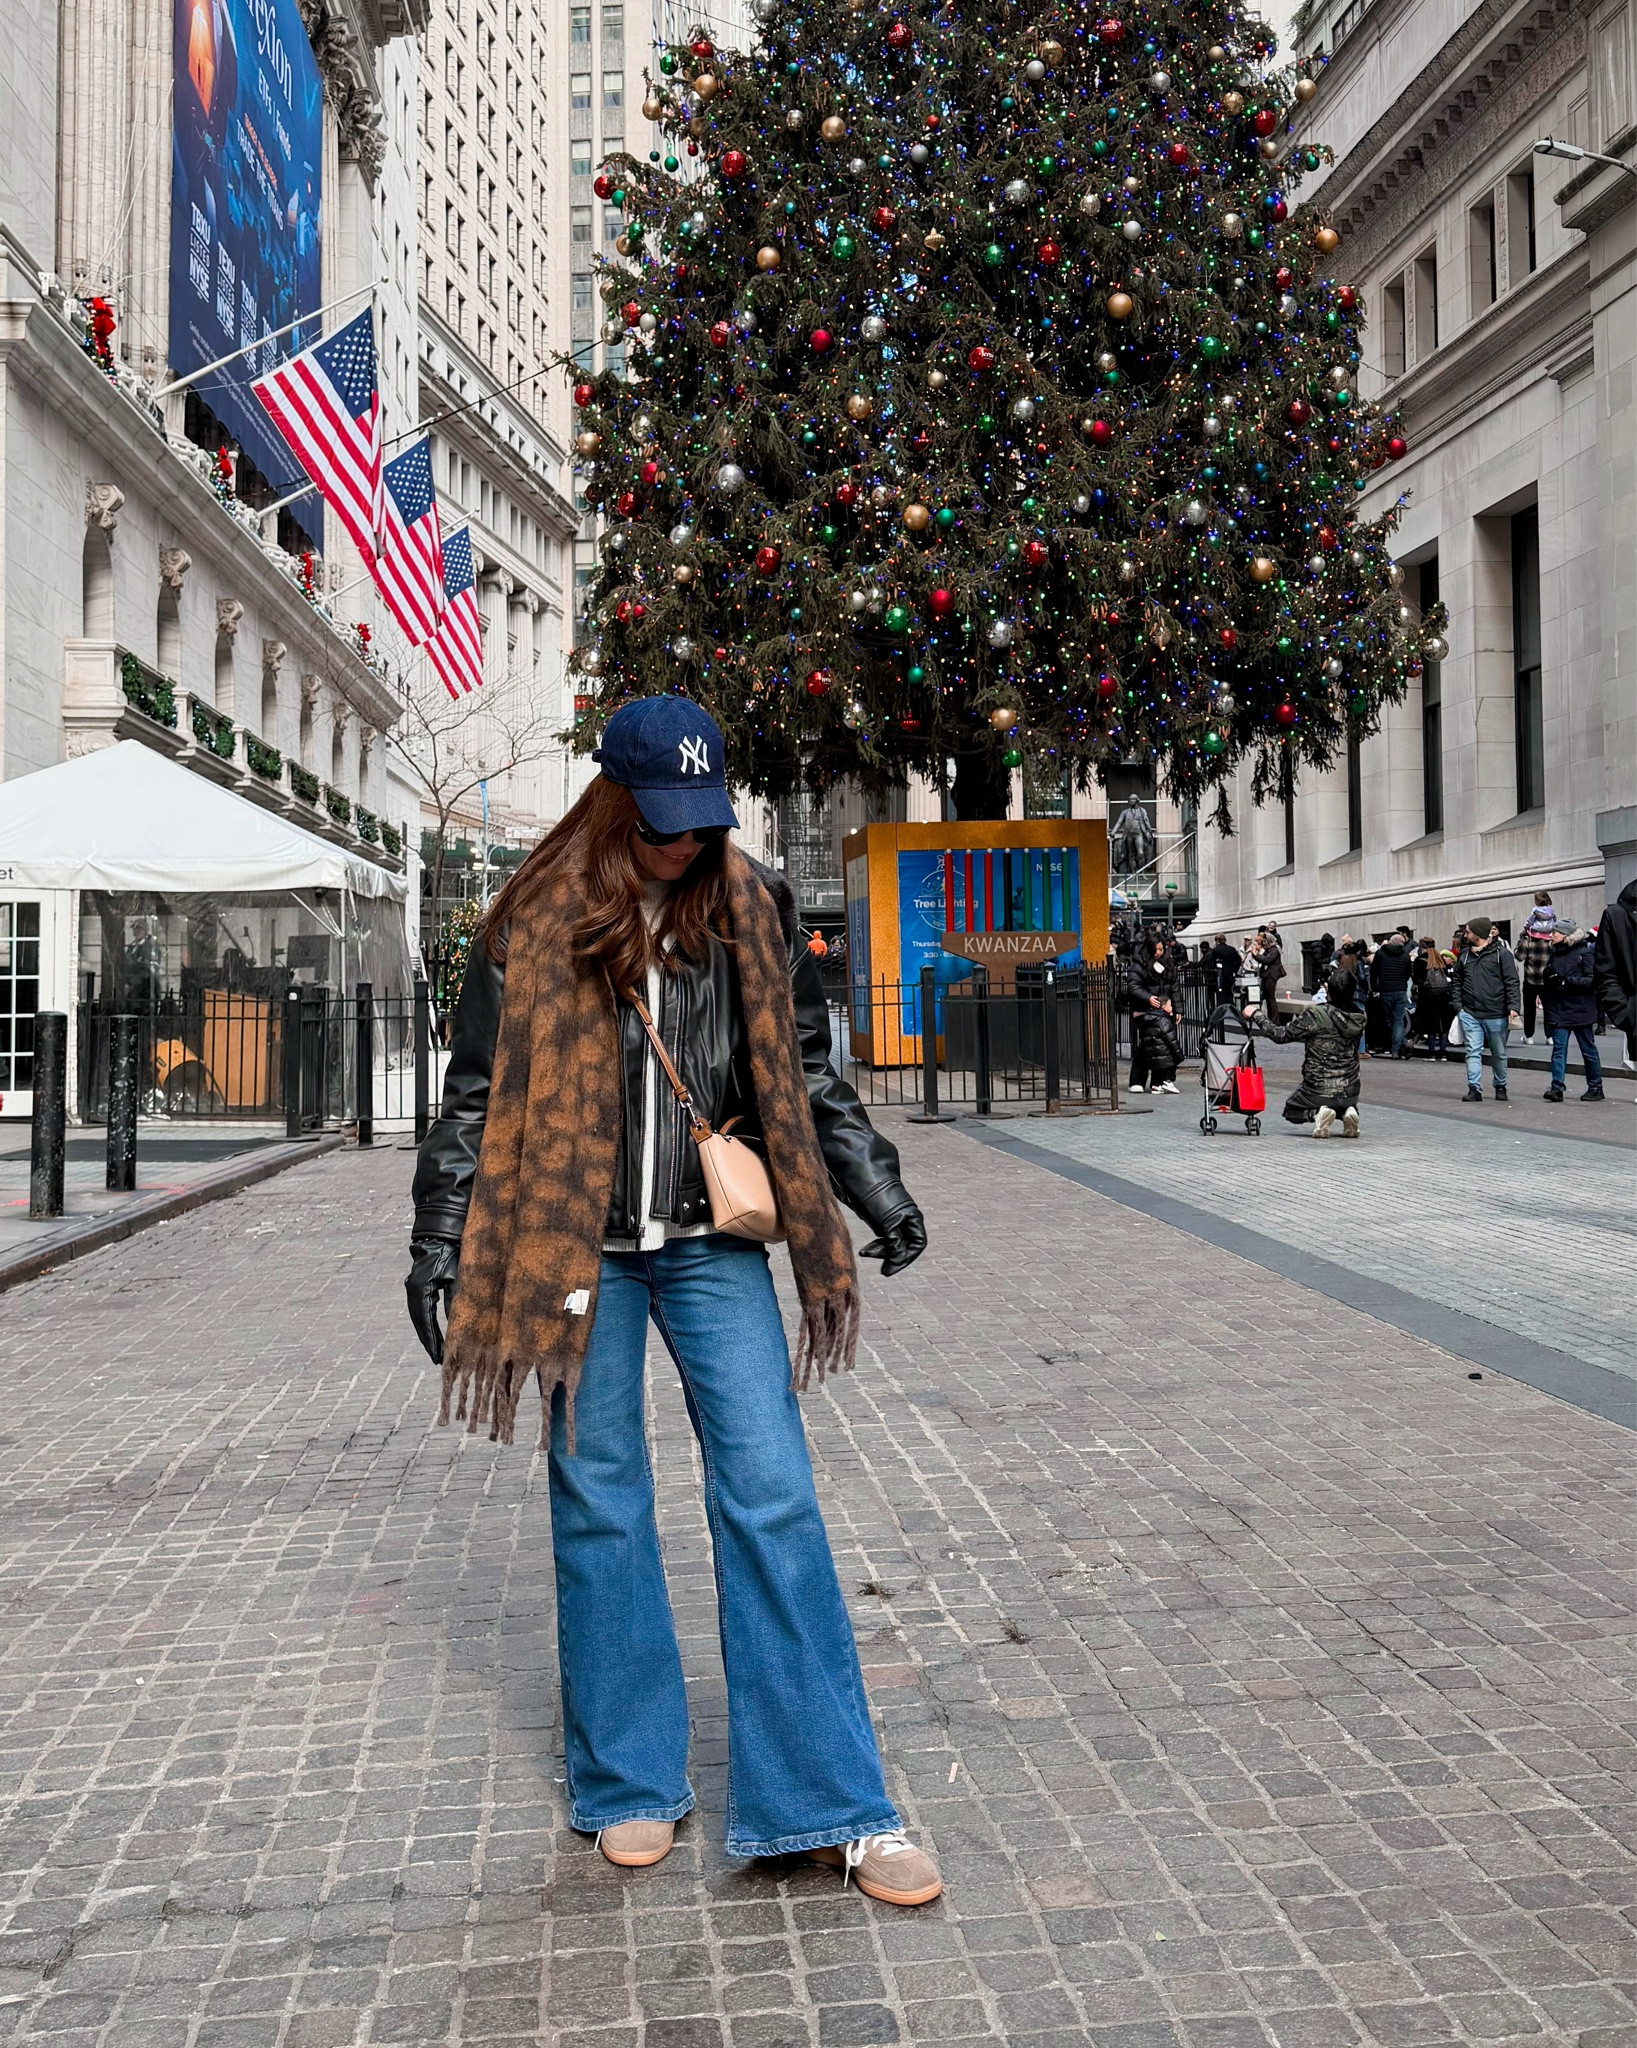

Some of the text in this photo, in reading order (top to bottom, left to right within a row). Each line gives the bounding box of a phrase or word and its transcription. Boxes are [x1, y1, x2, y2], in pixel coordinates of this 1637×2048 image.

[237, 119, 255, 172] TRADE
[256, 158, 266, 195] THE
[191, 201, 211, 246] TBXU
[190, 232, 210, 268] LISTED
[217, 241, 236, 285] TEXU
[190, 253, 210, 299] NYSE
[217, 271, 235, 306] LISTED
[217, 291, 235, 336] NYSE
[1036, 862, 1063, 872] NSE
[913, 899, 936, 909] Tree
[964, 936, 1057, 953] KWANZAA
